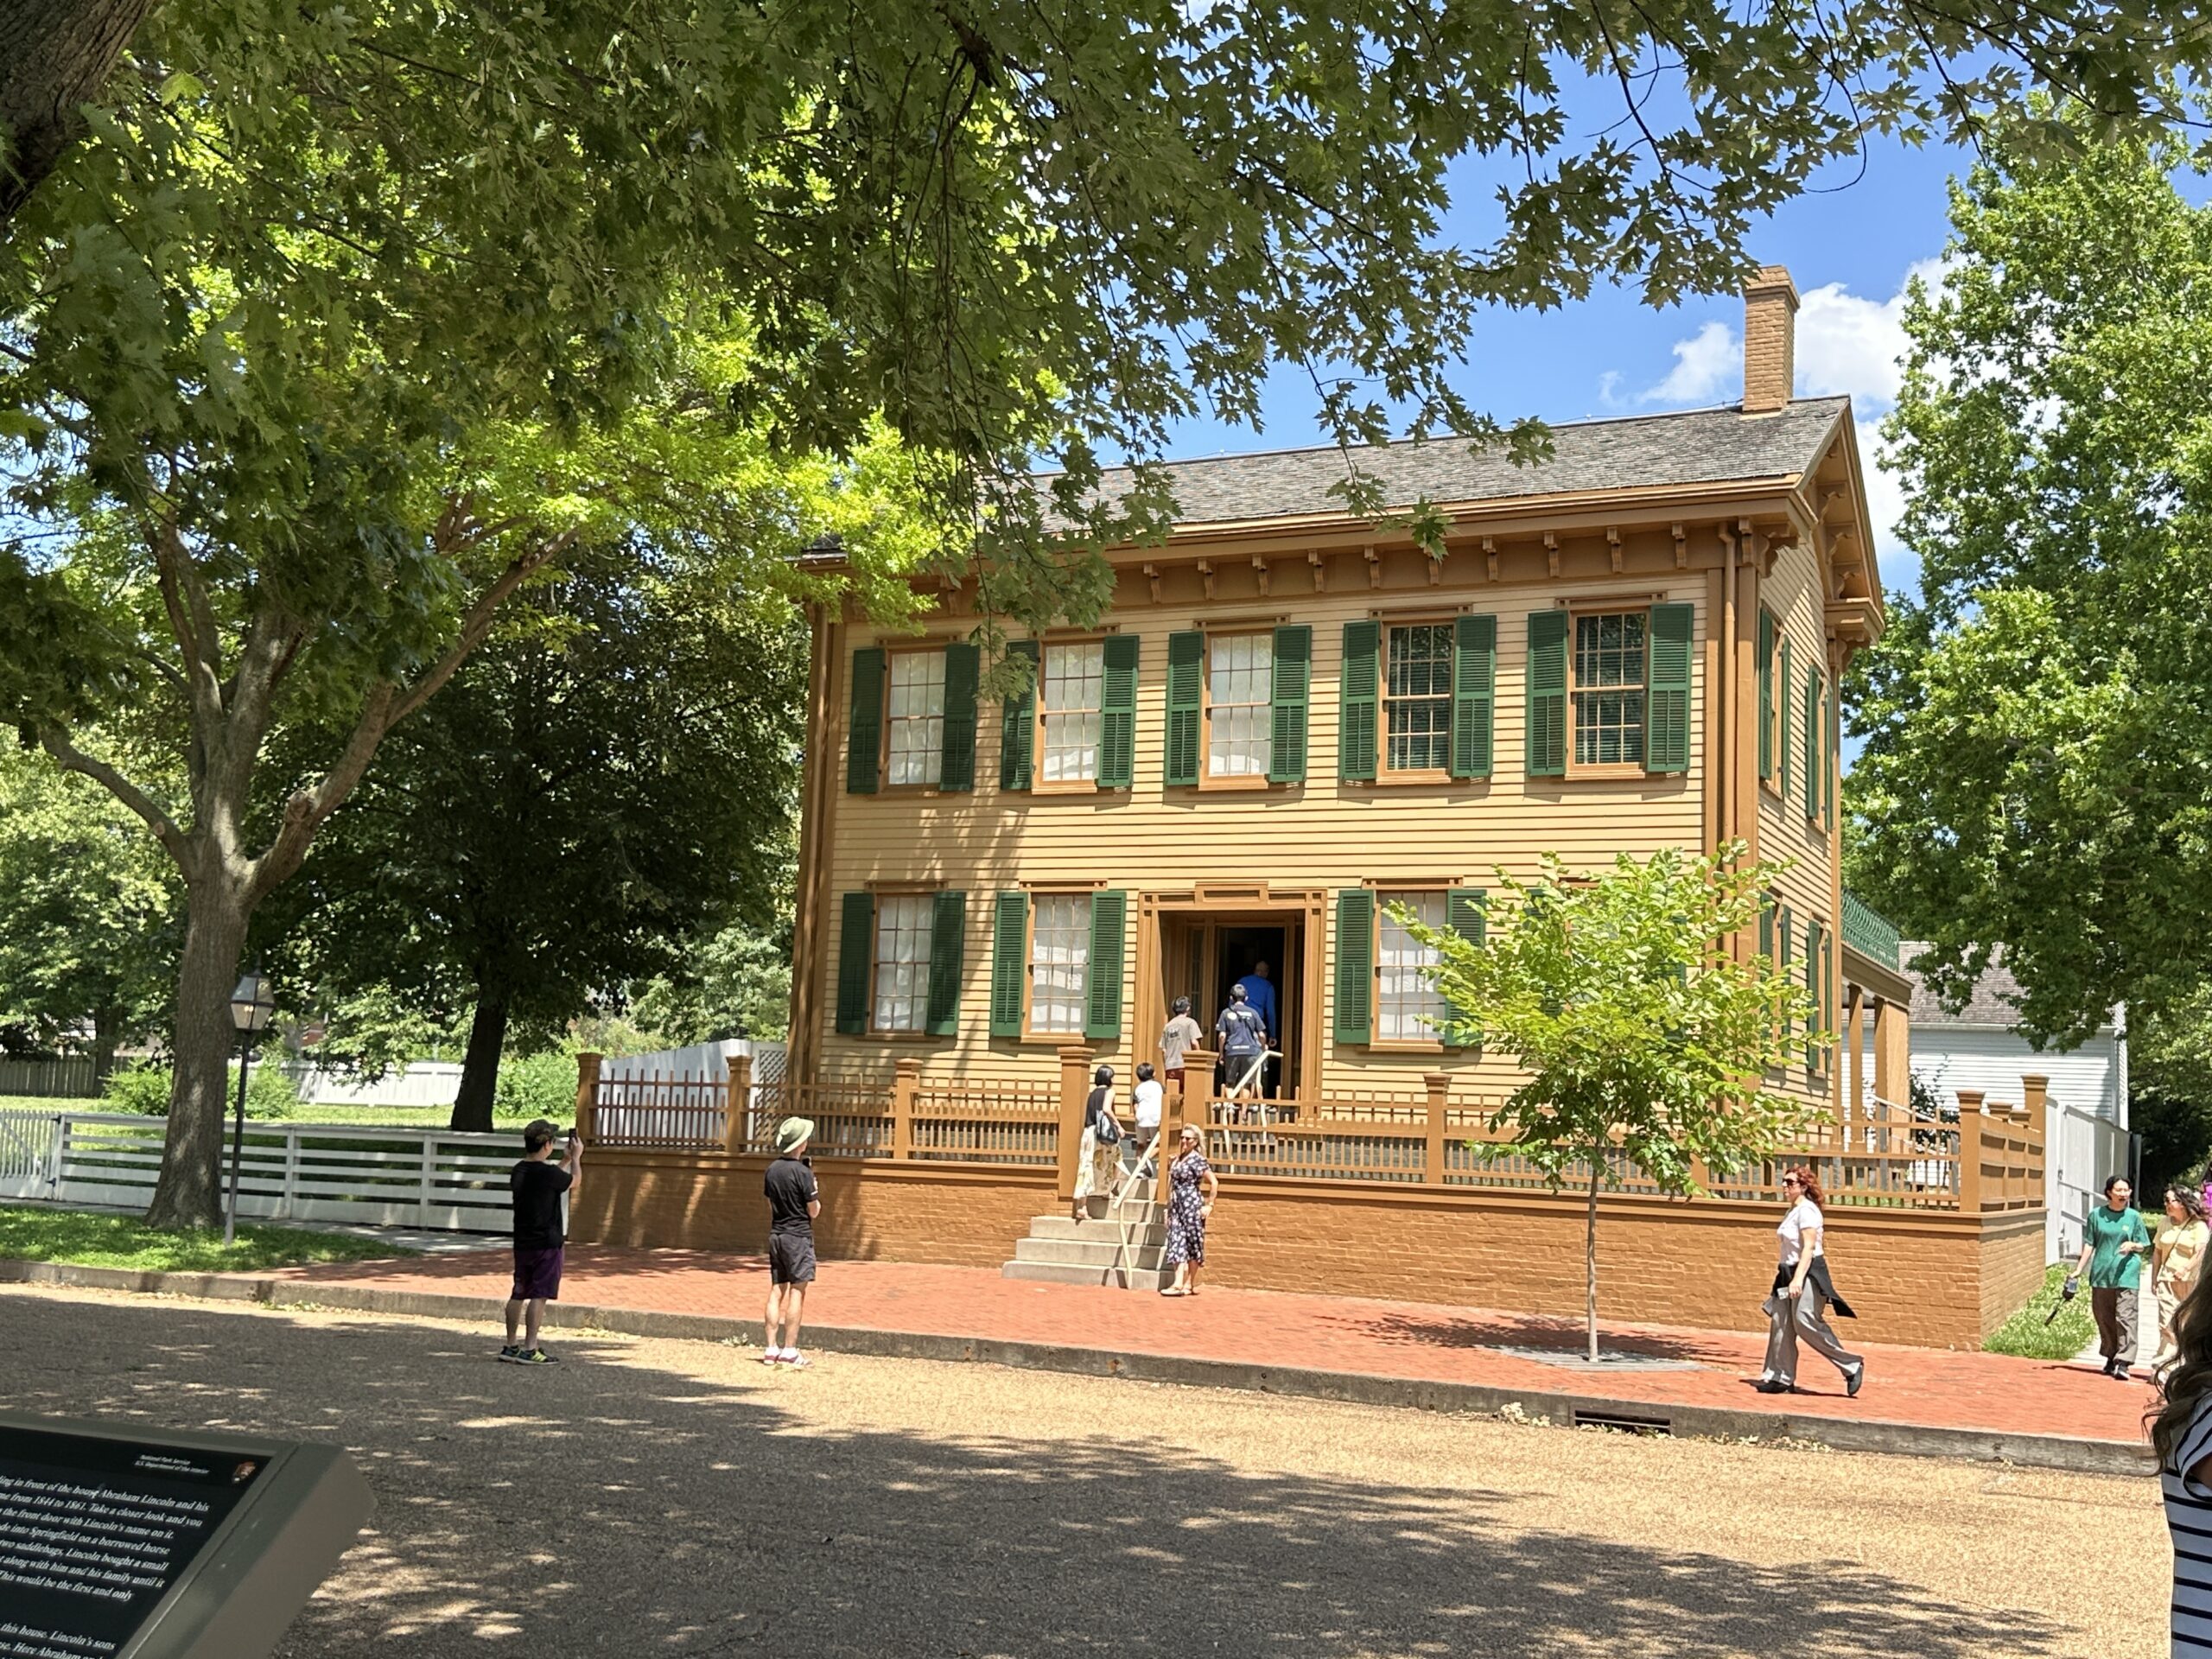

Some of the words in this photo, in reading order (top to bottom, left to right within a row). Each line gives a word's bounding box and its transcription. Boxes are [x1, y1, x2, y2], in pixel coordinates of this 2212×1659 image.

[24, 1479, 48, 1490] front
[46, 1483, 60, 1491] of
[101, 1489, 140, 1502] Abraham
[141, 1495, 175, 1506] Lincoln
[175, 1501, 196, 1510] and
[194, 1503, 209, 1511] his
[3, 1508, 17, 1516] the
[17, 1510, 41, 1519] front
[41, 1513, 63, 1522] door
[63, 1516, 83, 1526] with
[83, 1518, 124, 1531] Lincoln's
[124, 1526, 150, 1535] name
[10, 1493, 33, 1503] from
[34, 1496, 55, 1506] 1844
[89, 1503, 111, 1513] Take
[117, 1508, 145, 1518] closer
[144, 1510, 166, 1521] look
[183, 1518, 203, 1527] you
[10, 1524, 29, 1534] into
[29, 1527, 80, 1541] Springfield
[99, 1536, 145, 1550] borrowed
[143, 1543, 170, 1554] horse
[16, 1542, 64, 1556] saddlebags,
[66, 1548, 101, 1560] Lincoln
[101, 1553, 134, 1567] bought
[141, 1561, 169, 1571] small
[3, 1556, 29, 1568] along
[29, 1560, 50, 1569] with
[49, 1562, 68, 1573] him
[87, 1567, 102, 1577] his
[102, 1570, 131, 1584] family
[132, 1577, 157, 1586] until
[156, 1579, 165, 1587] it
[16, 1576, 46, 1586] would
[44, 1578, 57, 1587] be
[57, 1580, 73, 1590] the
[73, 1583, 94, 1593] first
[92, 1587, 114, 1596] and
[112, 1590, 132, 1601] only
[0, 1623, 19, 1633] this
[19, 1625, 48, 1638] house.
[49, 1630, 93, 1646] Lincoln's
[92, 1641, 116, 1649] sons
[13, 1643, 37, 1655] Here
[36, 1647, 81, 1659] Abraham
